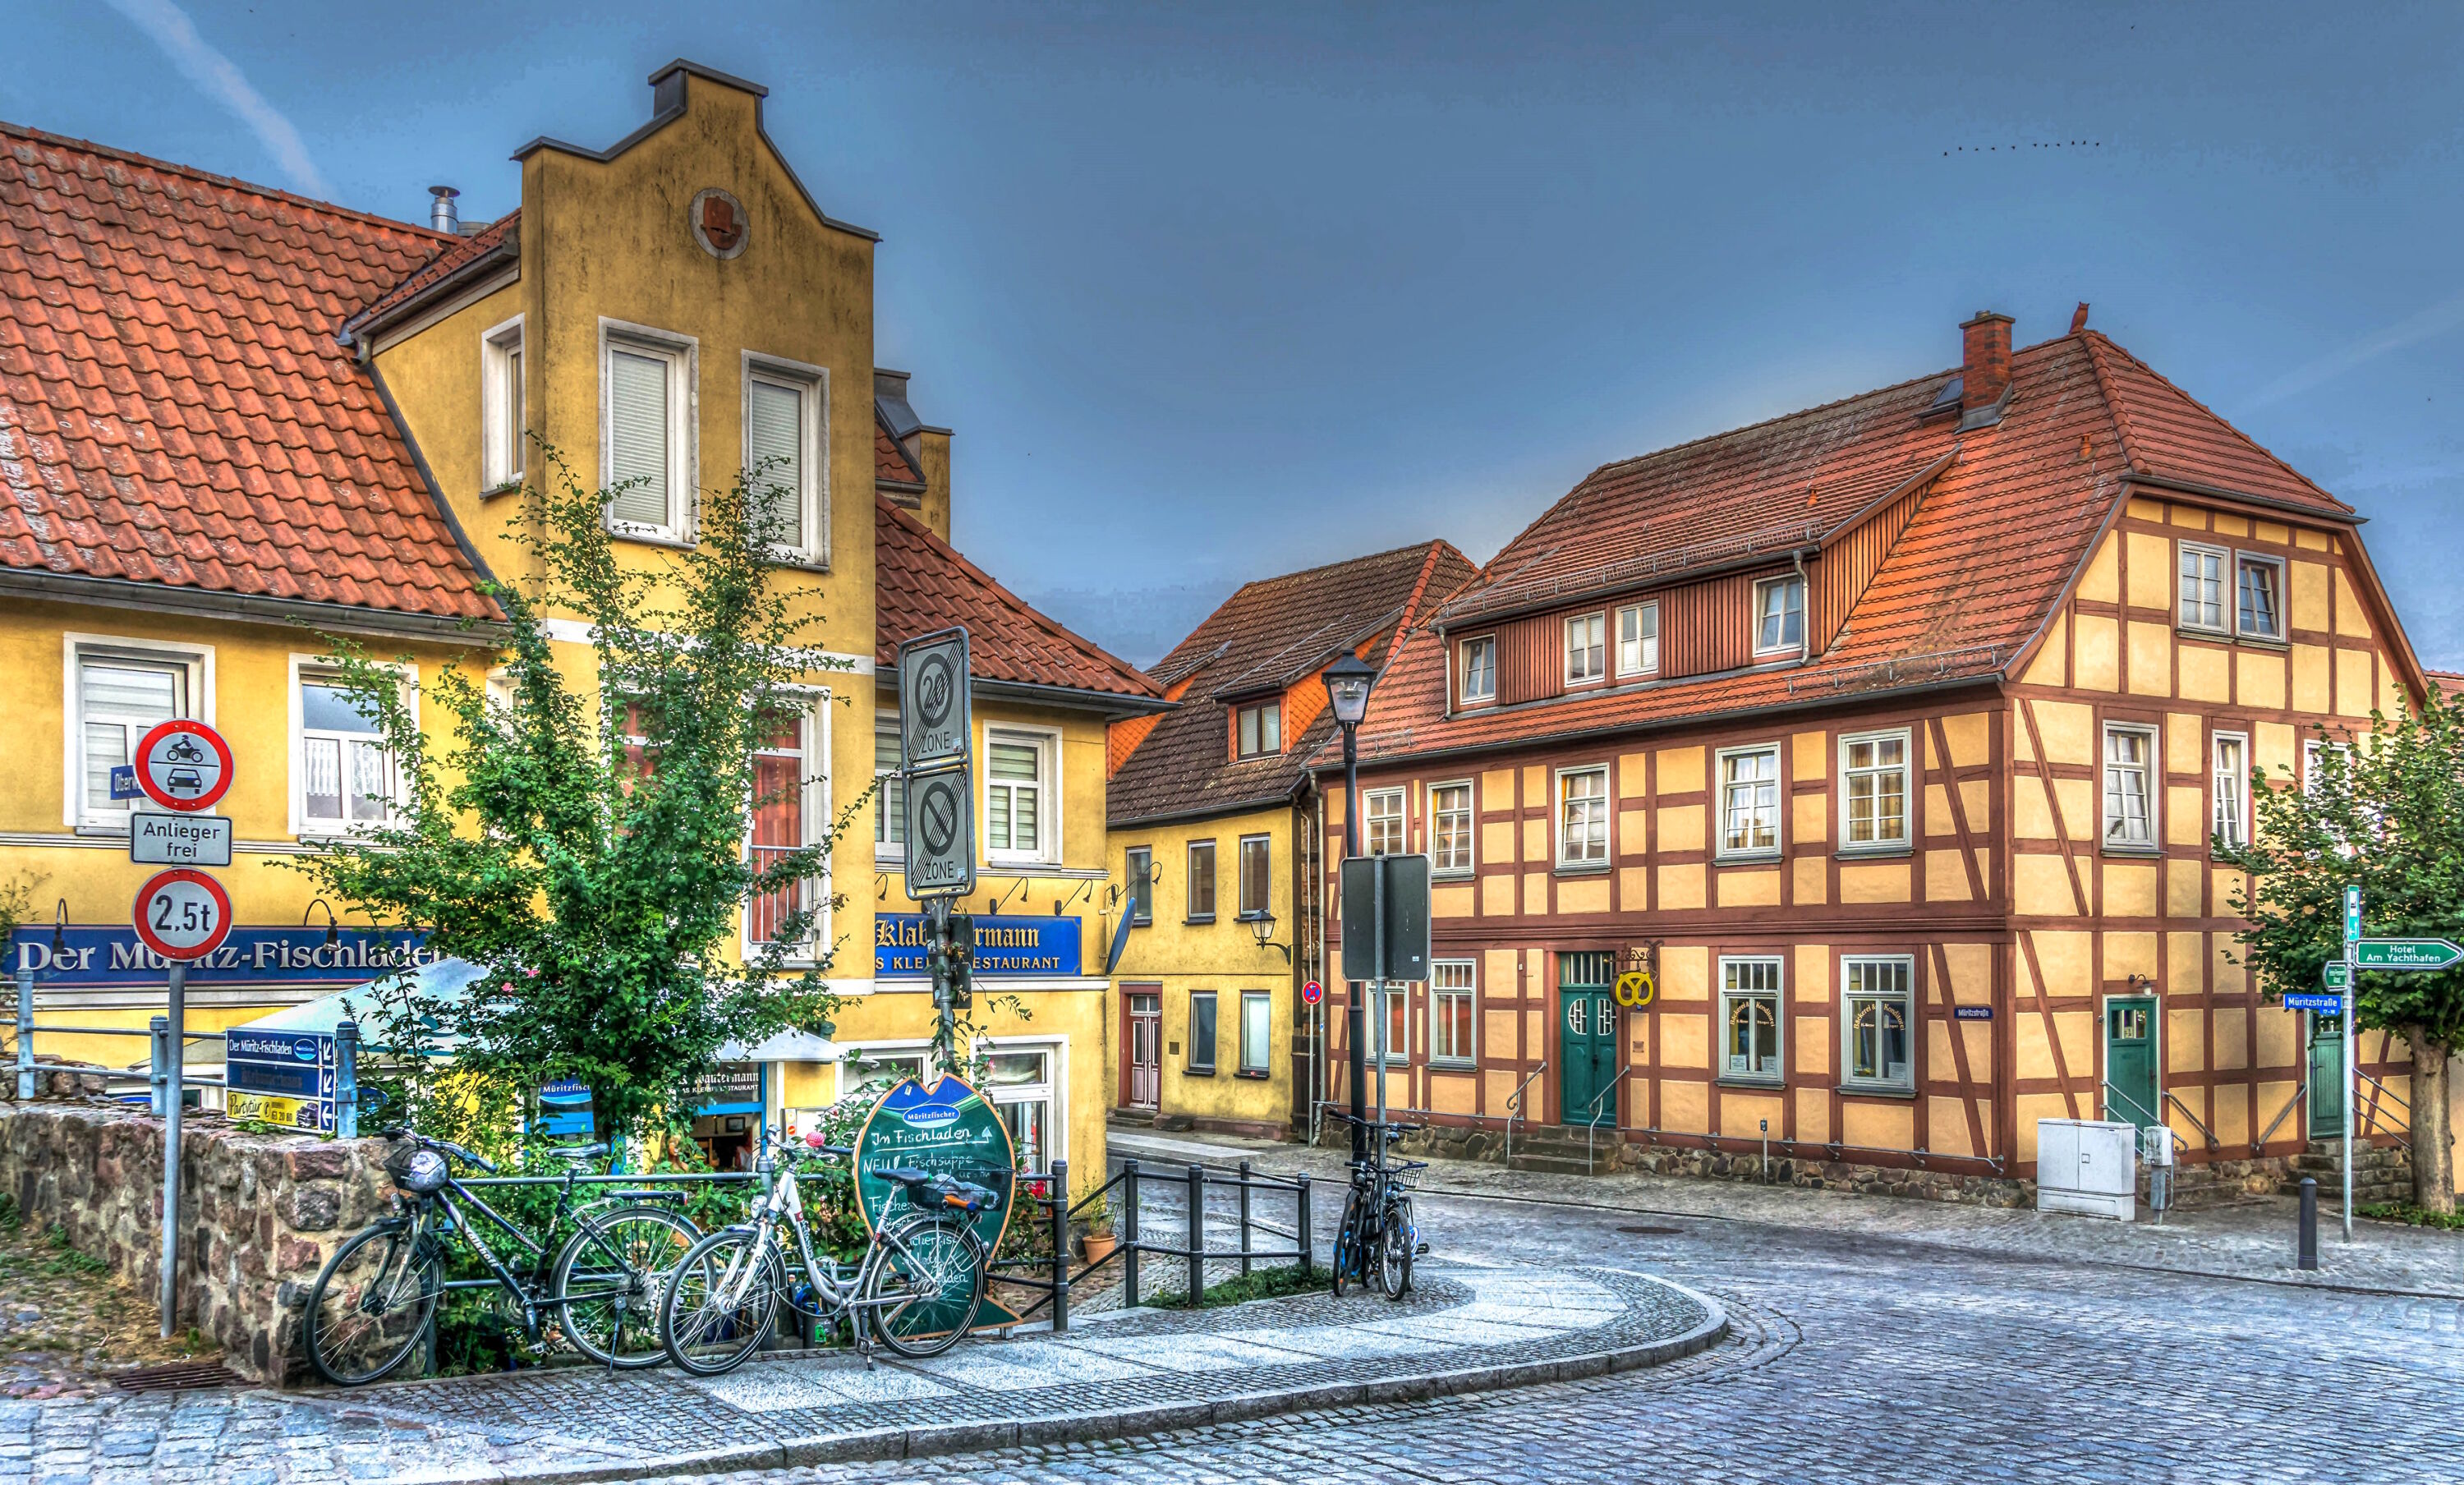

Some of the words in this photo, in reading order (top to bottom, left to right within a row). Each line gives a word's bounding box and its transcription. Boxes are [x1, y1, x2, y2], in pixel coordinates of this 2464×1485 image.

[921, 731, 950, 754] ZONE
[143, 821, 221, 842] Anlieger
[167, 842, 197, 857] frei
[926, 860, 954, 880] ZONE
[17, 942, 96, 971] Der
[2389, 945, 2416, 954] Hotel
[894, 957, 930, 969] KLEI
[972, 957, 1060, 969] ESTAURANT
[2366, 954, 2383, 962] Am
[2387, 954, 2441, 963] Yachthafen
[2287, 996, 2338, 1007] Müritzstraße
[1853, 1004, 1872, 1030] Bäckerei
[1883, 1003, 1905, 1031] Konditorei
[228, 1039, 240, 1051] Der
[241, 1039, 292, 1055] Müritz-Fischladen
[908, 1111, 956, 1120] Müritzfischer
[893, 1127, 972, 1144] Fischladen
[905, 1151, 975, 1169] Fischsuppe
